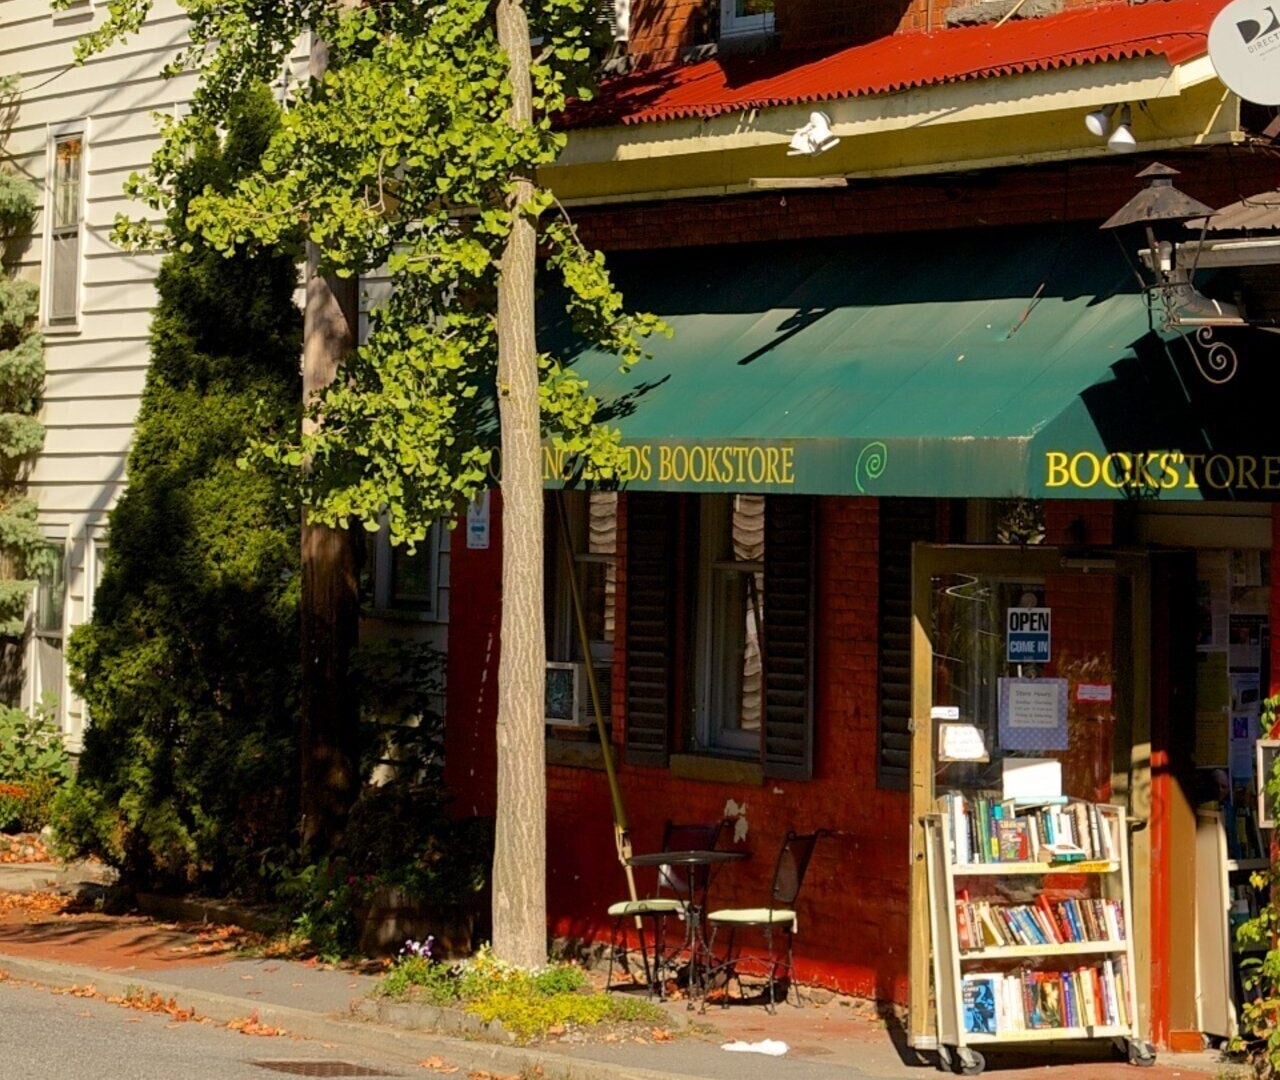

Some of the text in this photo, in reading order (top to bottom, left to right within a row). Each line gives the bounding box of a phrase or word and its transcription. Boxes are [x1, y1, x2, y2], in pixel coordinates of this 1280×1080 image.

[658, 445, 795, 484] BOOKSTORE
[1009, 611, 1049, 631] OPEN
[1010, 640, 1049, 653] COME IN
